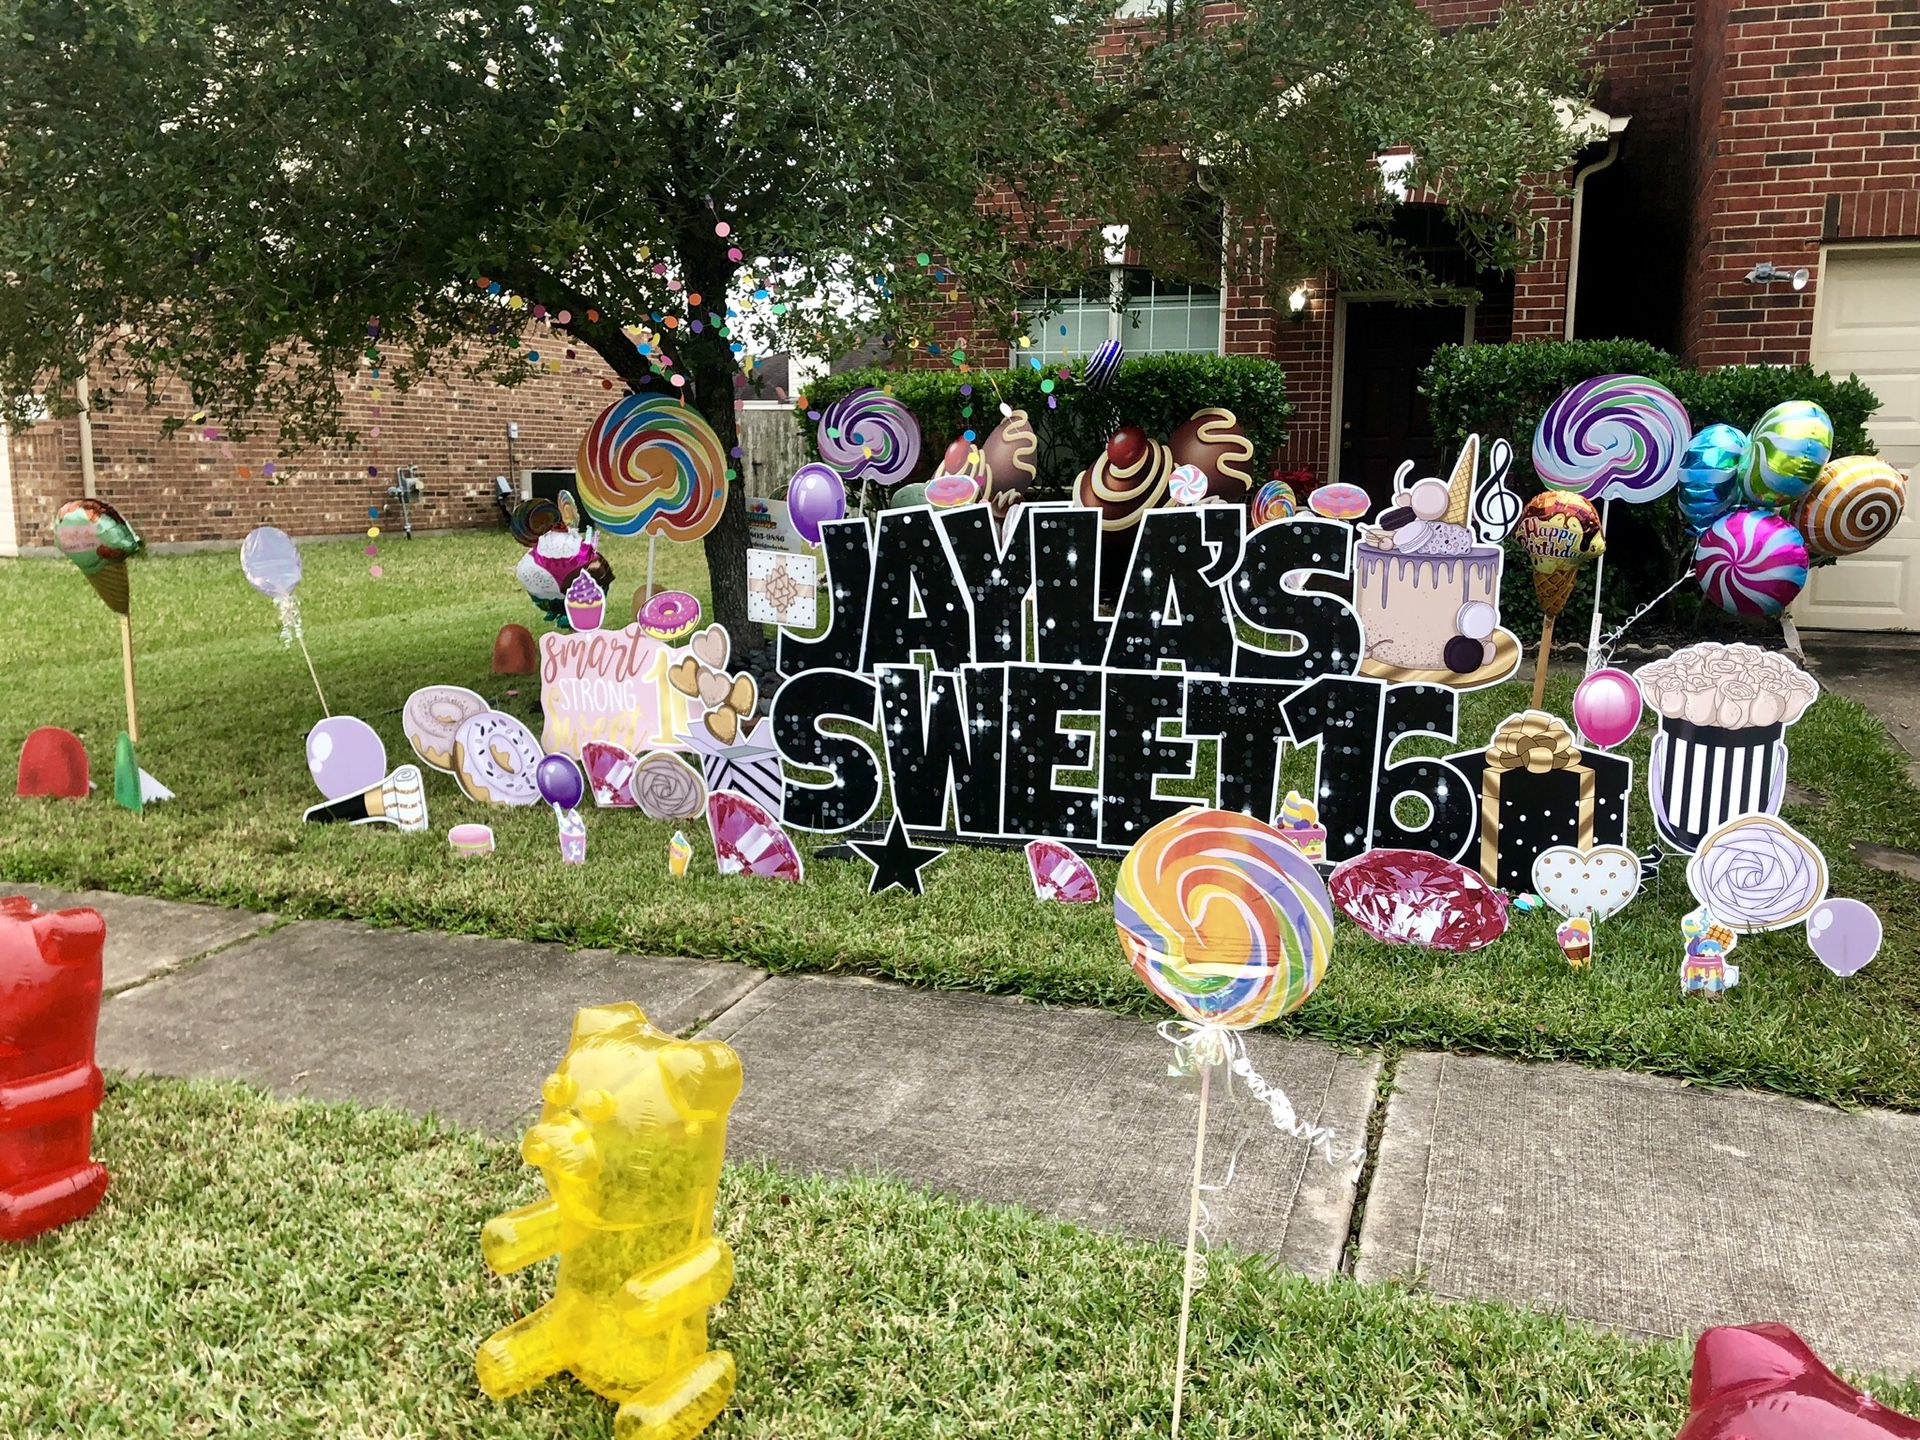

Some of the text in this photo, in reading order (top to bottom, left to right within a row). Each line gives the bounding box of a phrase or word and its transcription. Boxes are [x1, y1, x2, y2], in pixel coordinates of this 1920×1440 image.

[1524, 516, 1578, 542] Happy
[776, 502, 1365, 685] JAYLA'S
[544, 627, 649, 684] smart
[557, 676, 638, 713] STRONG
[641, 649, 691, 747] 1
[769, 662, 1478, 867] SWEET 16
